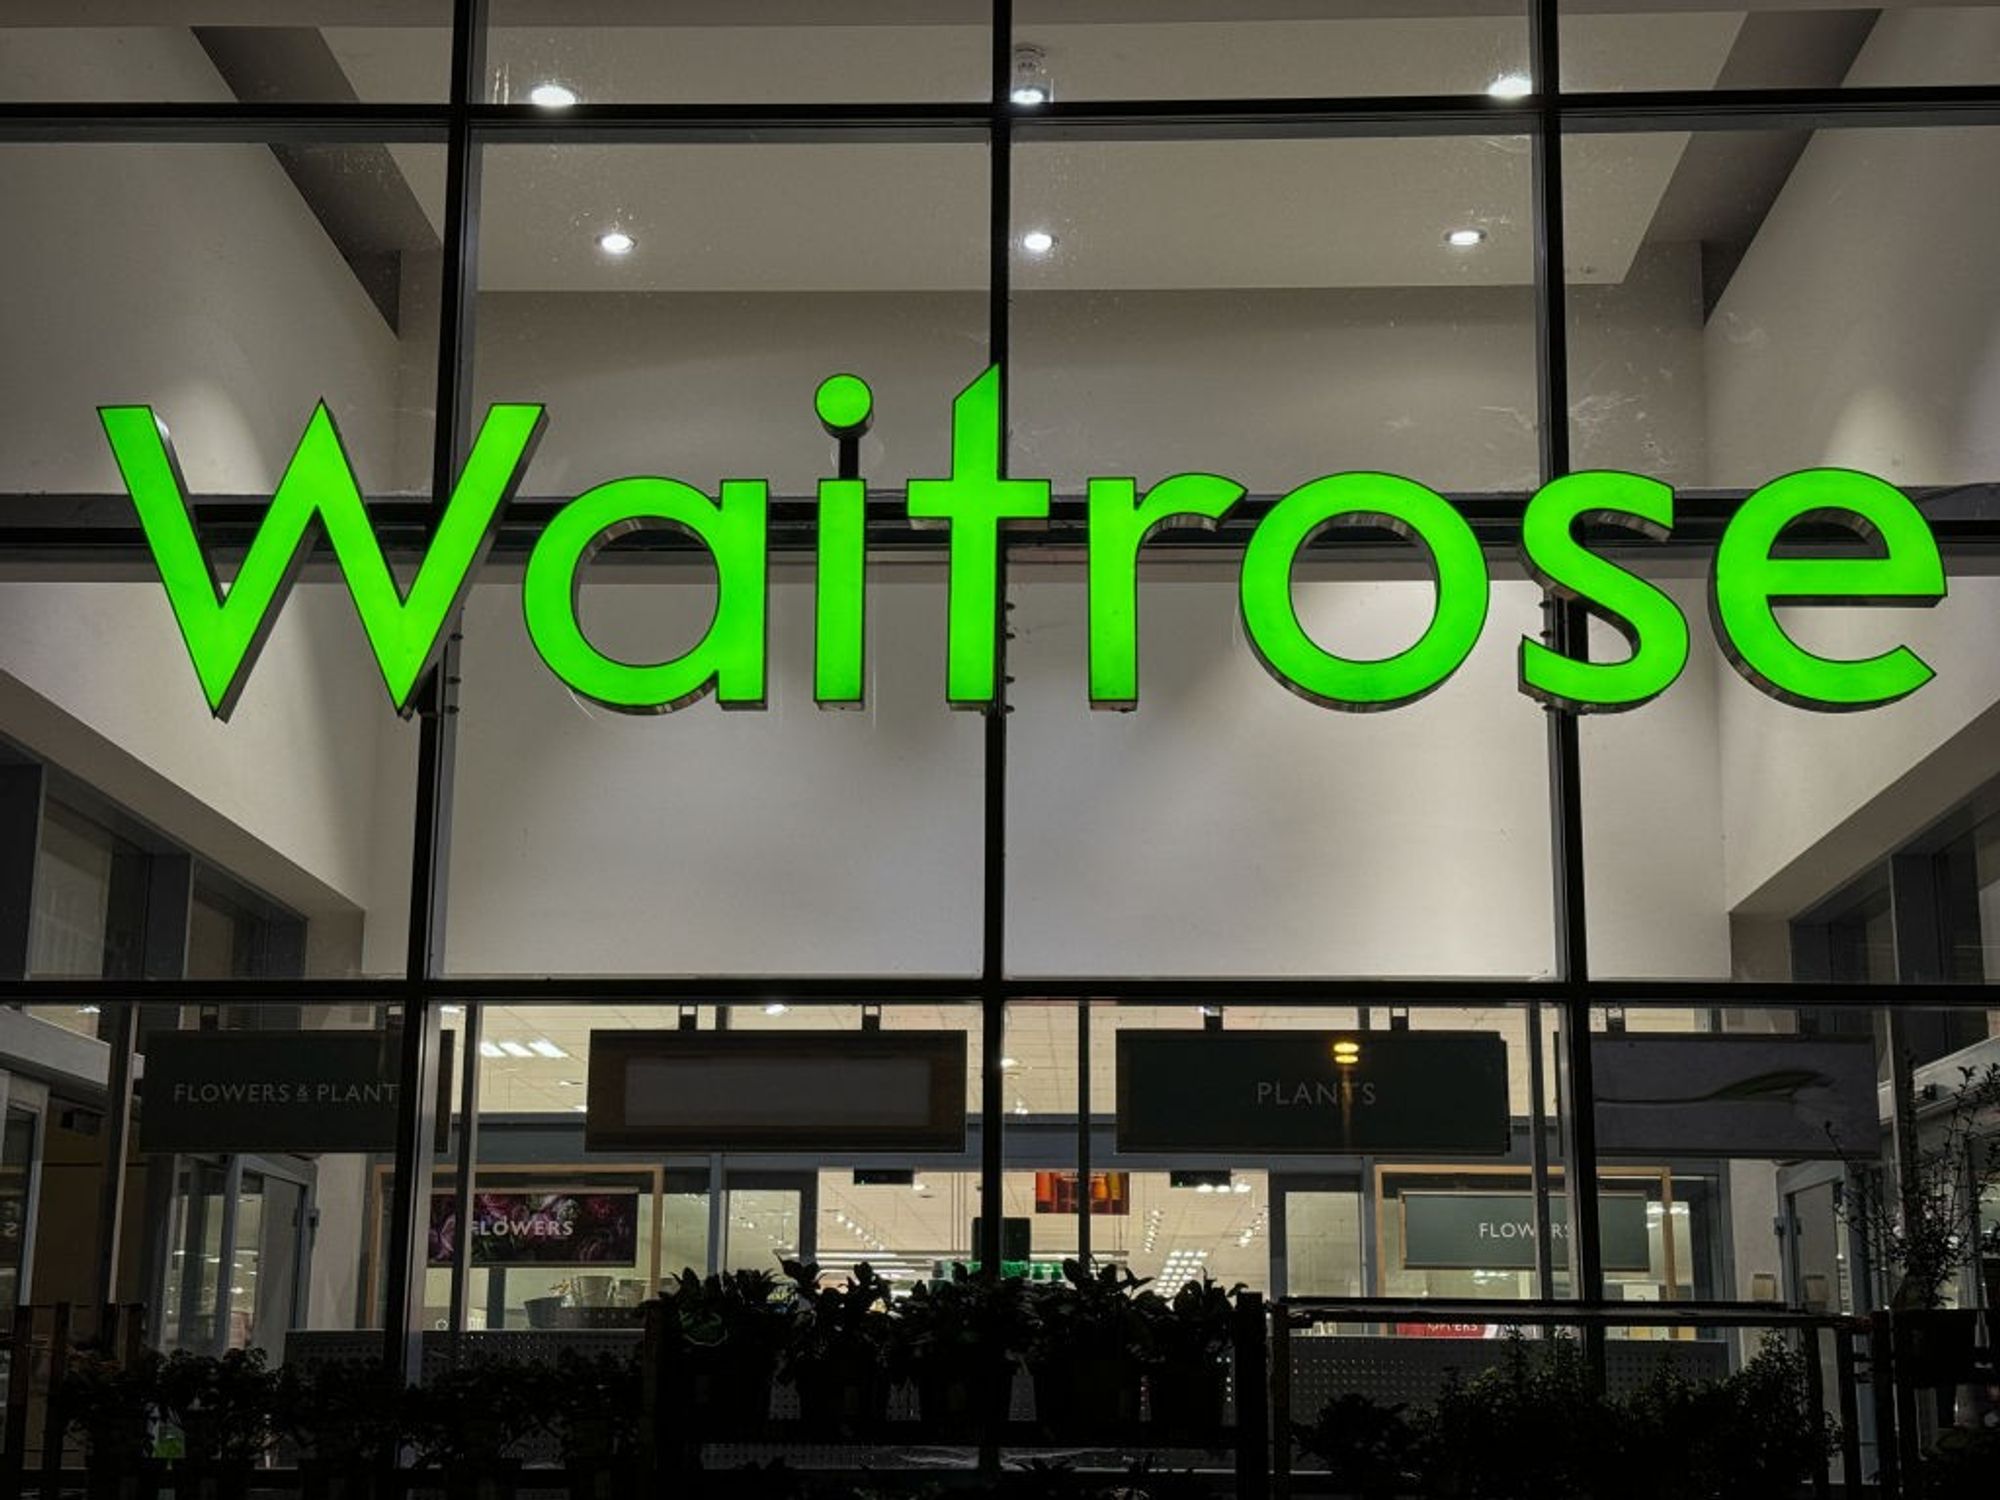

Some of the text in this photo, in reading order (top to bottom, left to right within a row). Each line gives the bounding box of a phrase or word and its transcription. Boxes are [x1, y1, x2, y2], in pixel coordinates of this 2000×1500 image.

[99, 364, 1947, 711] Waitrose
[174, 1083, 401, 1103] FLOWERS & PLANT
[1257, 1080, 1377, 1105] PLANTS
[1479, 1222, 1571, 1239] FLOWR
